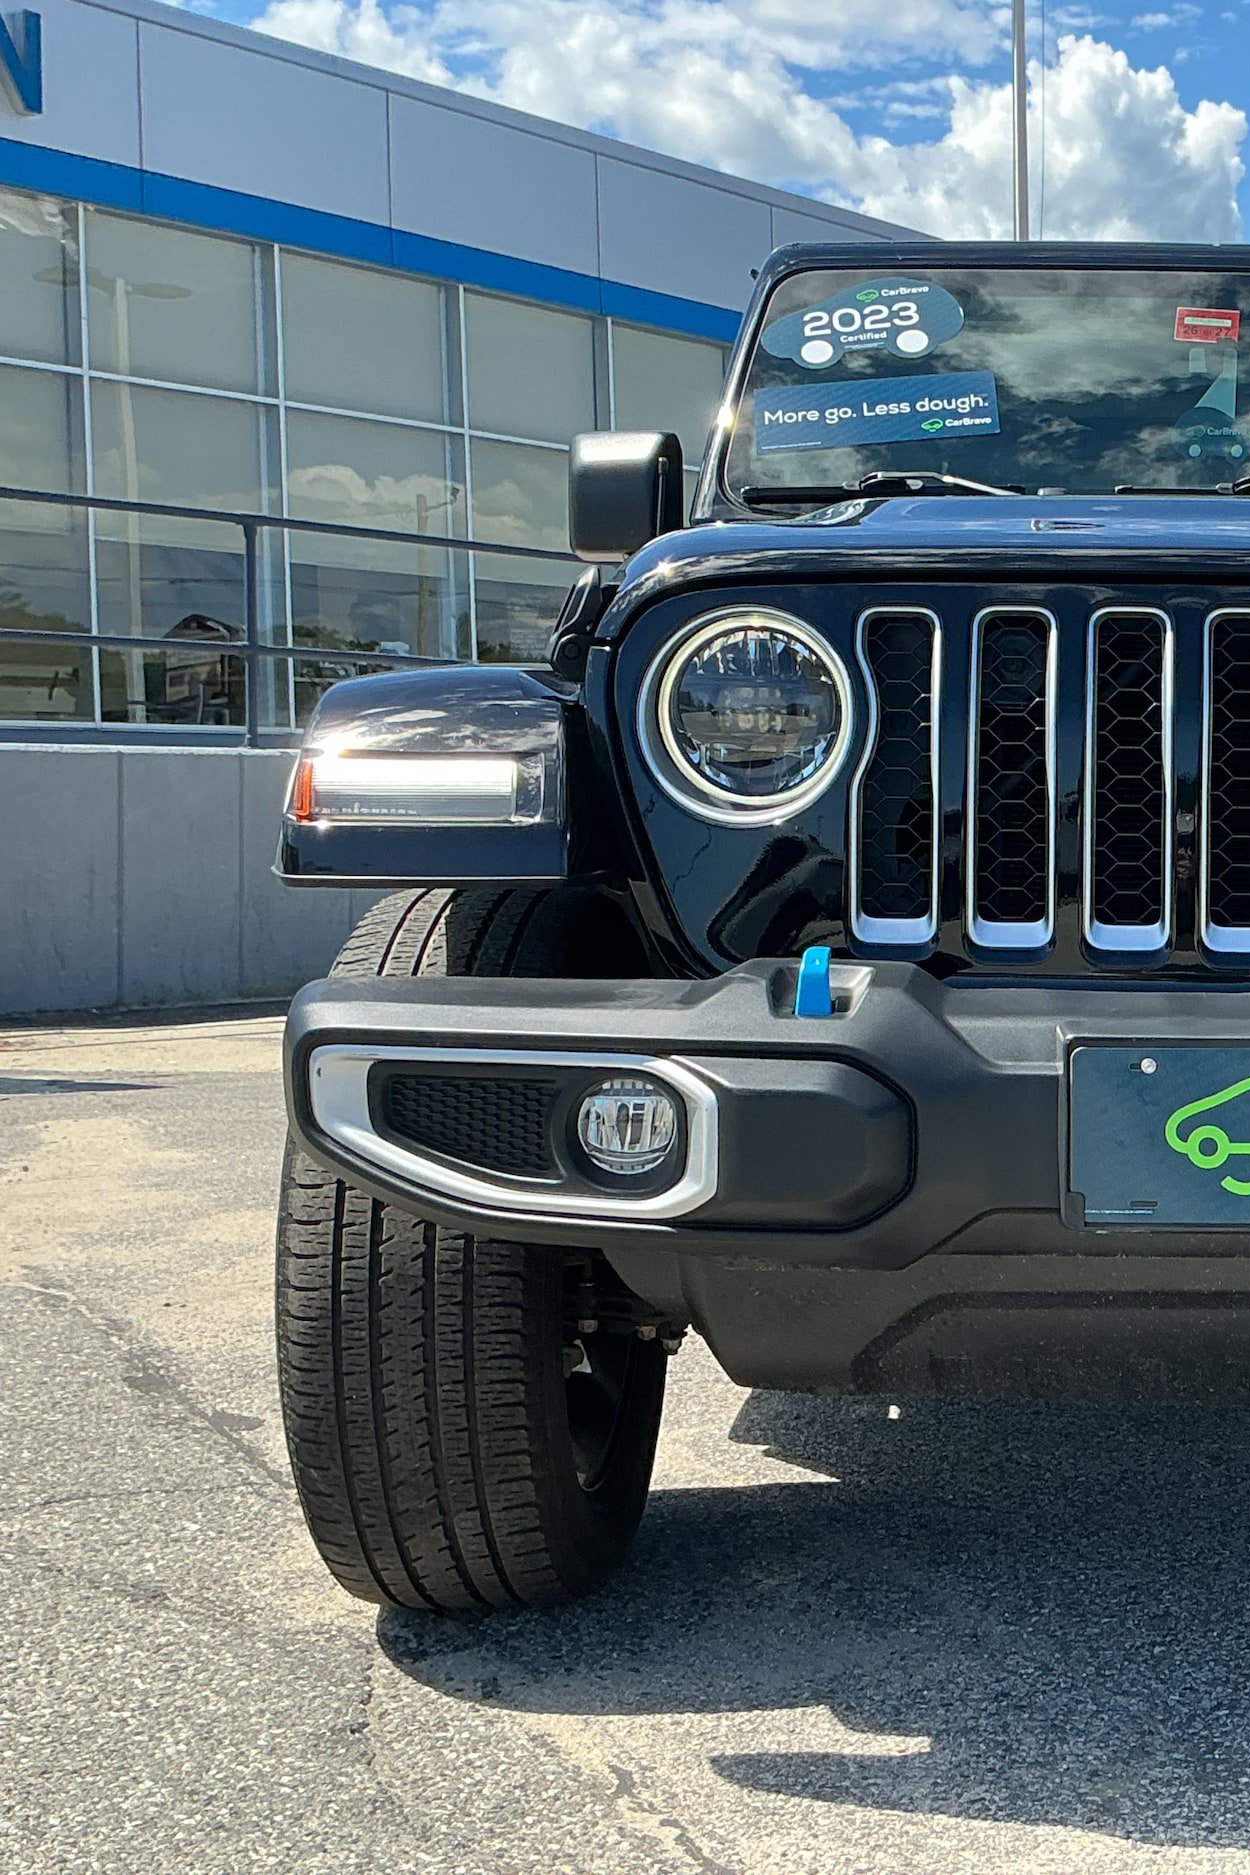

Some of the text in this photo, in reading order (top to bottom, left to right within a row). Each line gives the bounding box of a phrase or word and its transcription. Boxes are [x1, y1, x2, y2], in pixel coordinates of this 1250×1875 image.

[881, 285, 930, 297] CarBravo
[802, 302, 920, 337] 2023
[840, 331, 888, 343] Certified
[763, 394, 989, 425] More go. Less dough.
[945, 416, 992, 427] CarBravo
